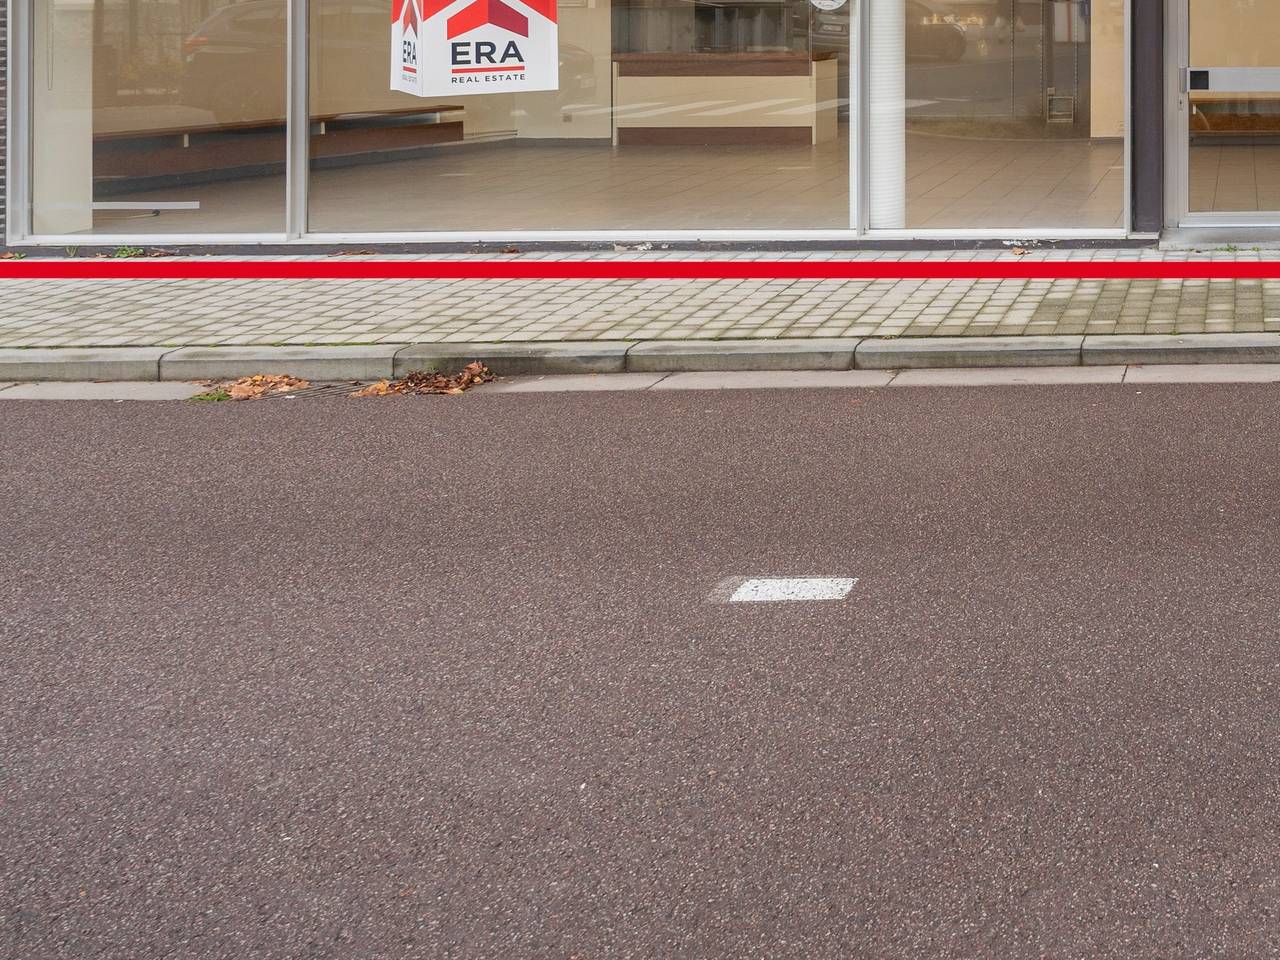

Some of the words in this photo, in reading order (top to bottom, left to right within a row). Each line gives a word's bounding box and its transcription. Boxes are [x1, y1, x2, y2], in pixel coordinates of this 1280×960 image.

[451, 40, 525, 66] ERA
[451, 74, 480, 84] REAL
[485, 73, 526, 82] ESTATE
